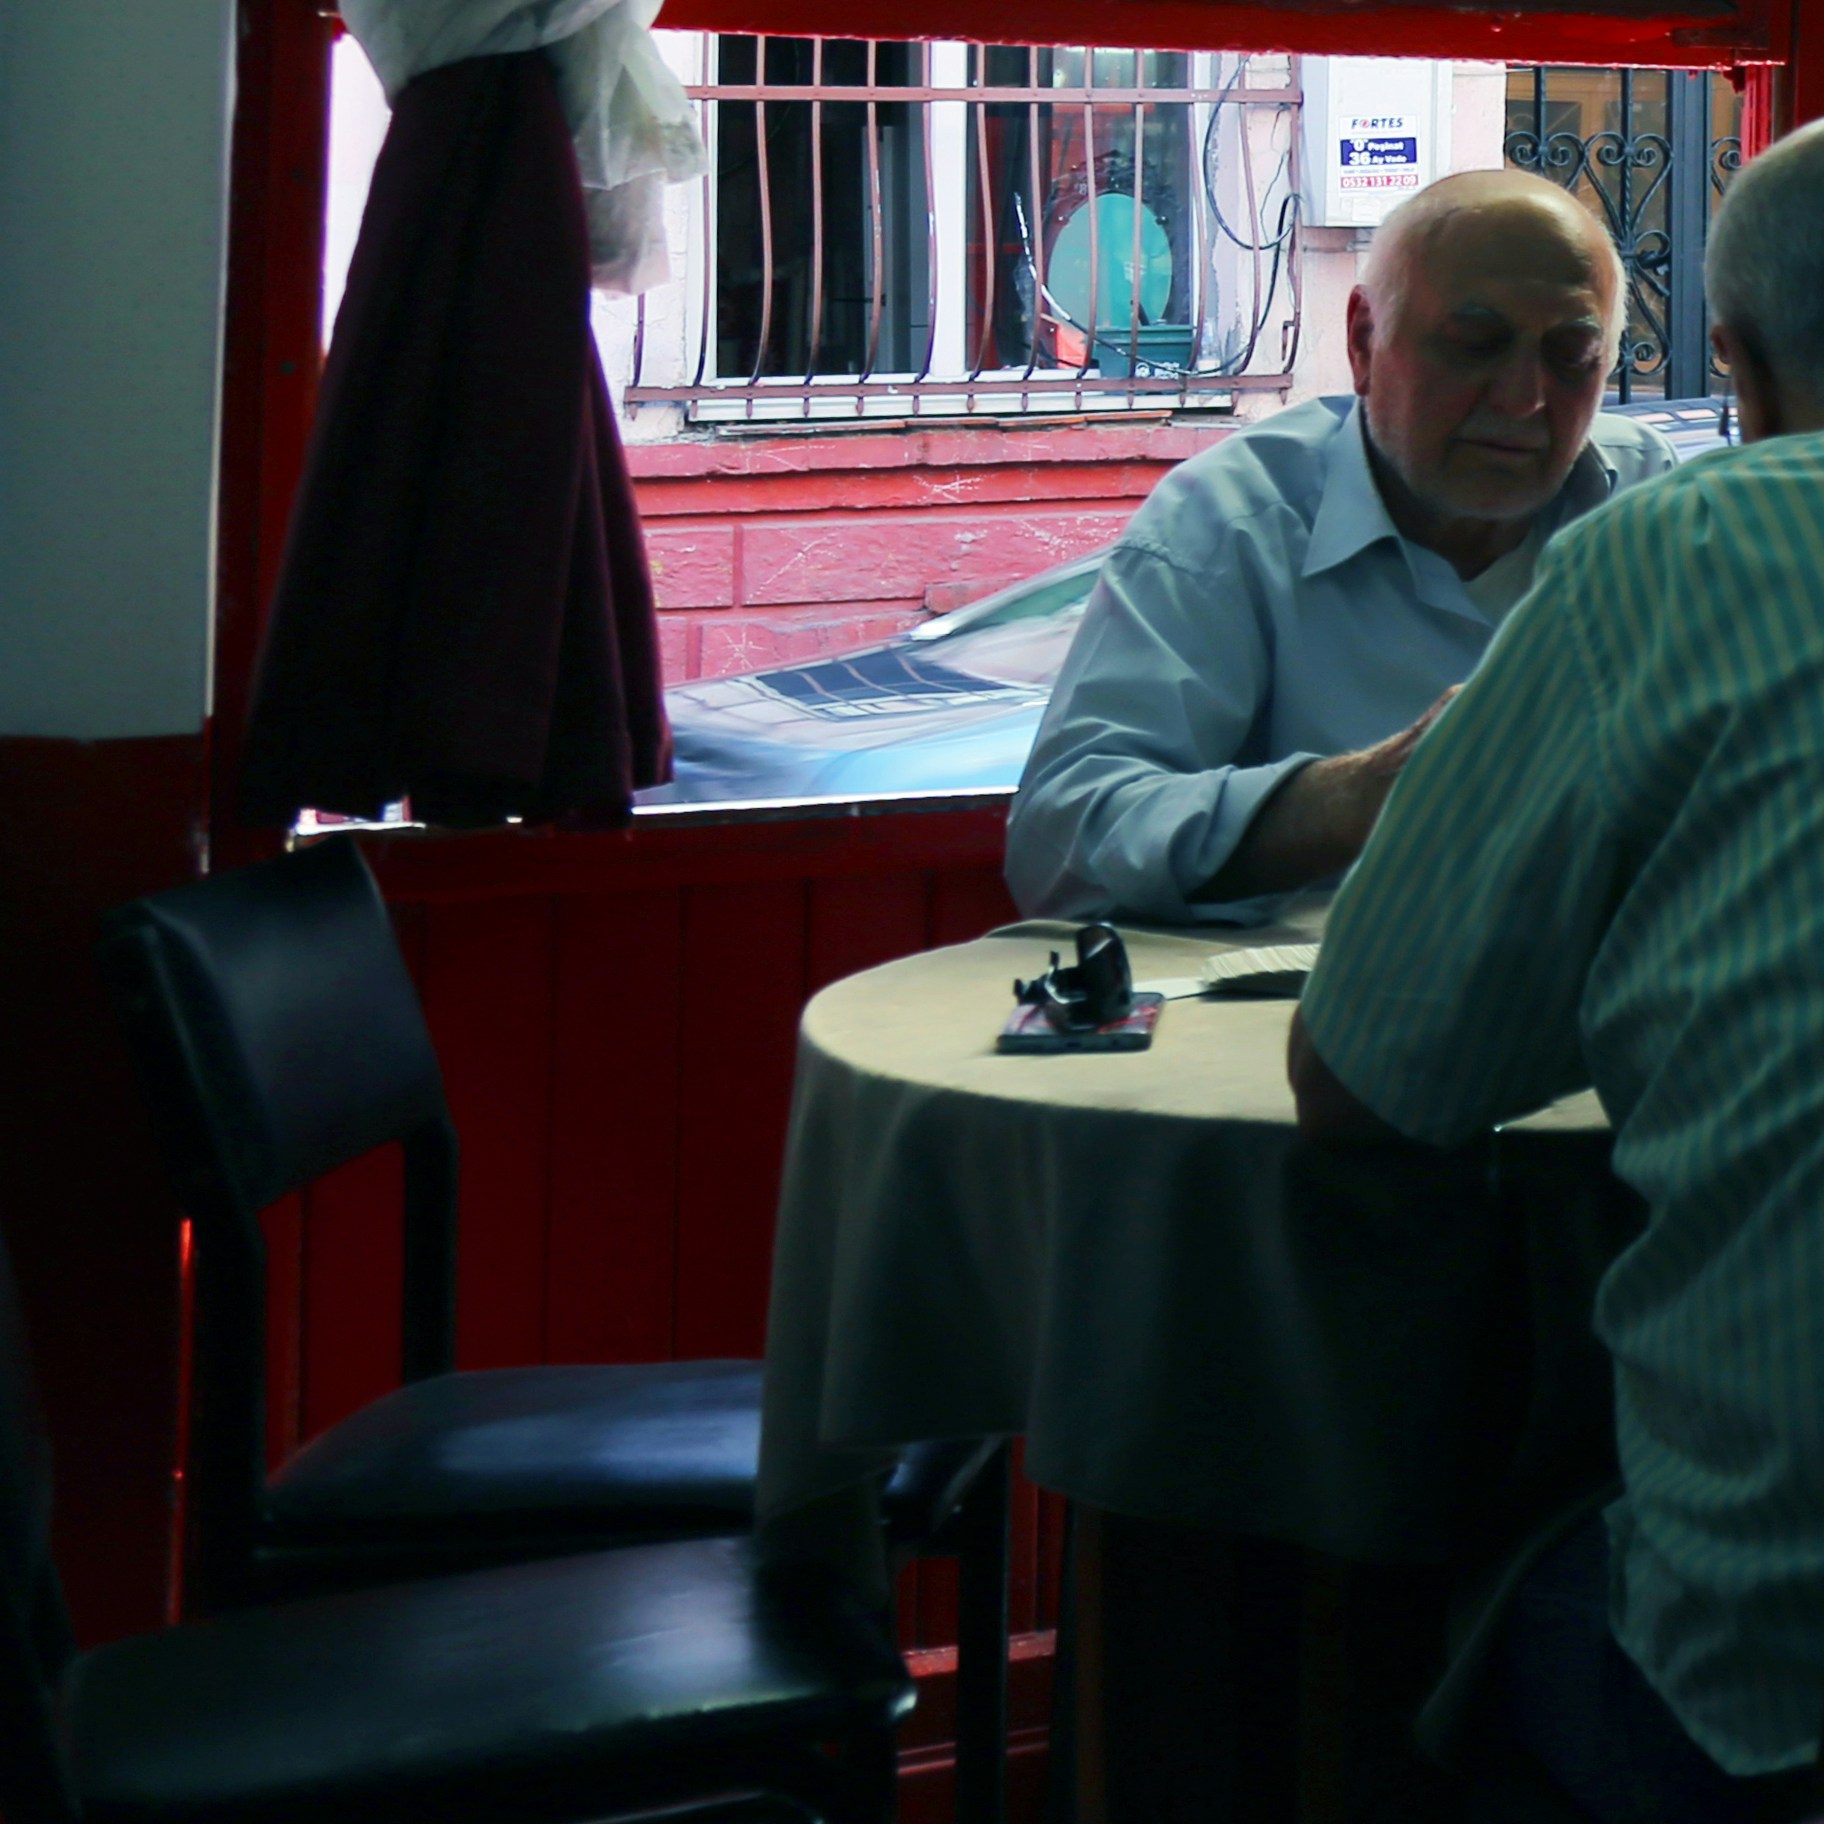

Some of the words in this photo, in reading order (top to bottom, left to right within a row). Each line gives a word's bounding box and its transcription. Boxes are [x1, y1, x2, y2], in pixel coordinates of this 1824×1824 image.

[1351, 117, 1404, 129] FORTES
[1349, 152, 1371, 165] 36
[1342, 176, 1368, 188] 0532
[1370, 176, 1388, 187] 131
